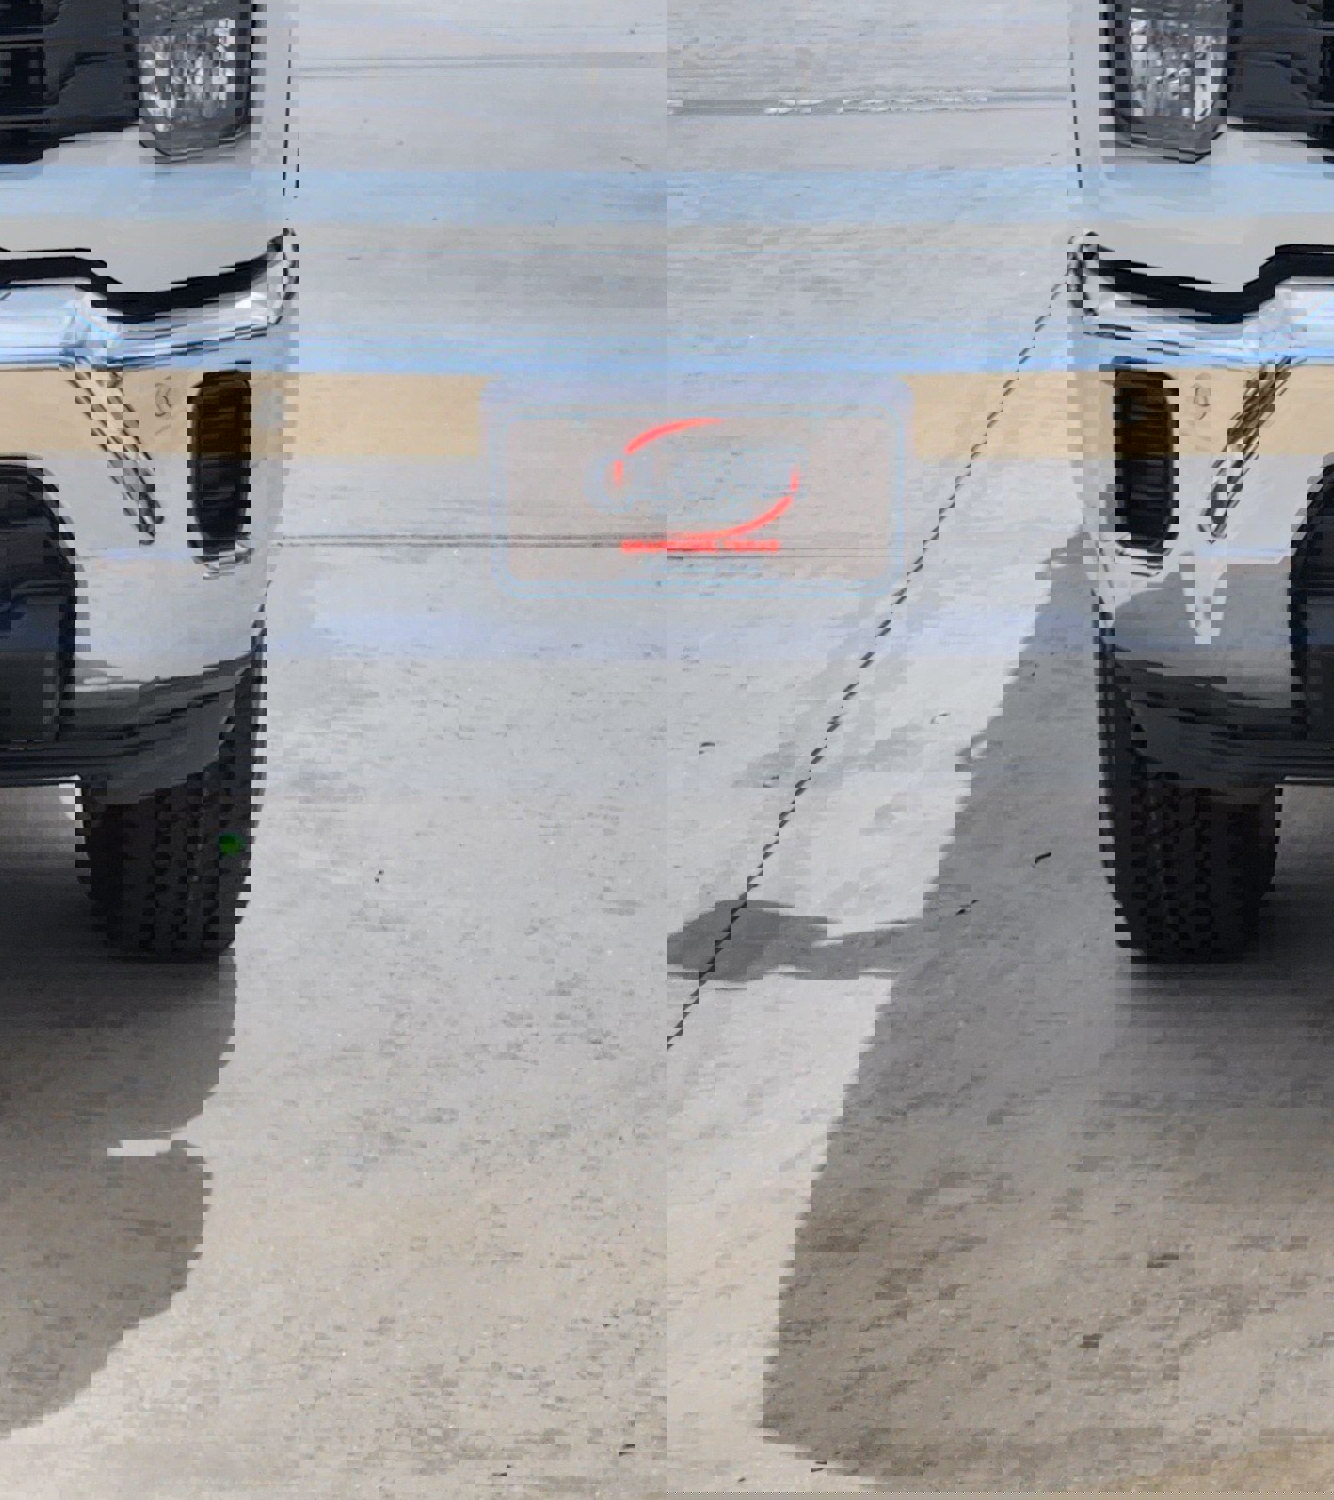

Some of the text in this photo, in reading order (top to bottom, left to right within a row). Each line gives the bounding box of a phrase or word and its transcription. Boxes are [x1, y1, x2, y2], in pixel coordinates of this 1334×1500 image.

[585, 449, 808, 513] CLASSIC
[651, 500, 751, 521] Chevrolet
[722, 539, 779, 553] TEXAS
